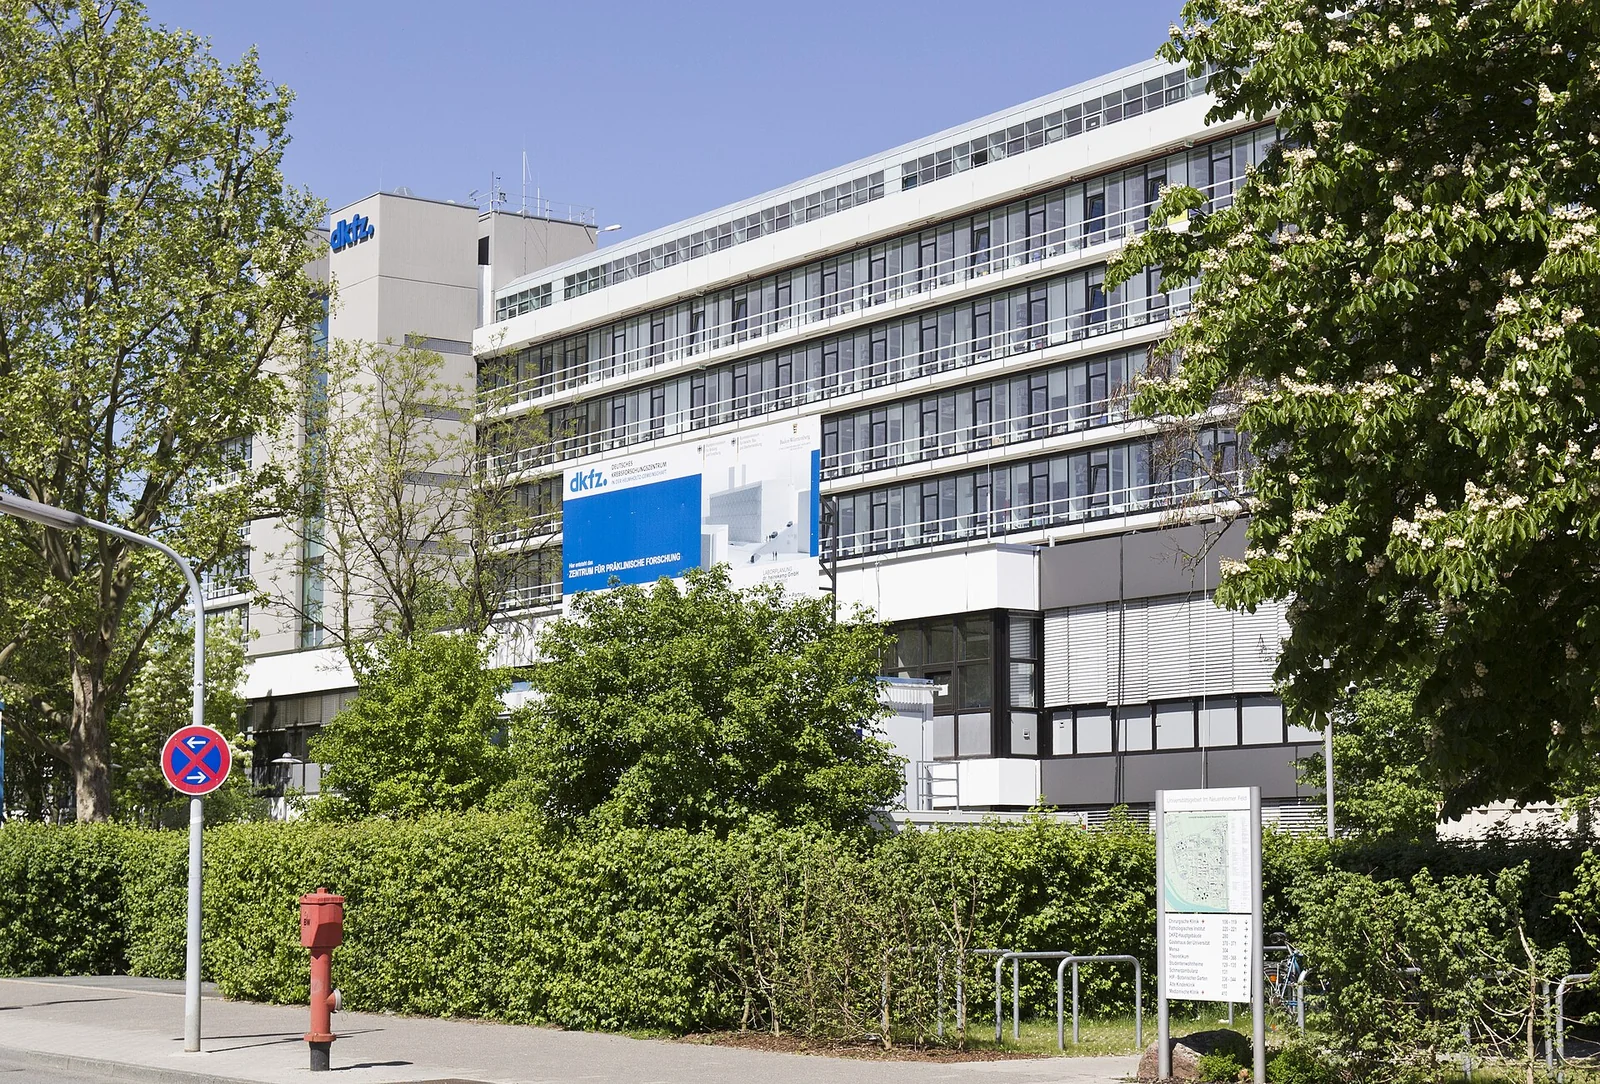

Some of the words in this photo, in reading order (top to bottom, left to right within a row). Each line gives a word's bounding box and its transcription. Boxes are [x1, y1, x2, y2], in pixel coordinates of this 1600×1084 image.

[331, 213, 375, 252] dkfz.
[611, 461, 634, 470] DEUTSCHES
[611, 462, 667, 478] KREBSFORSCHUNGSZENTRUM
[570, 469, 608, 492] dkfz.
[568, 568, 594, 578] ZENTRUM
[594, 564, 605, 575] FÜR
[606, 558, 645, 572] PRÄKLINISCHE
[646, 552, 681, 566] FORSCHUNG
